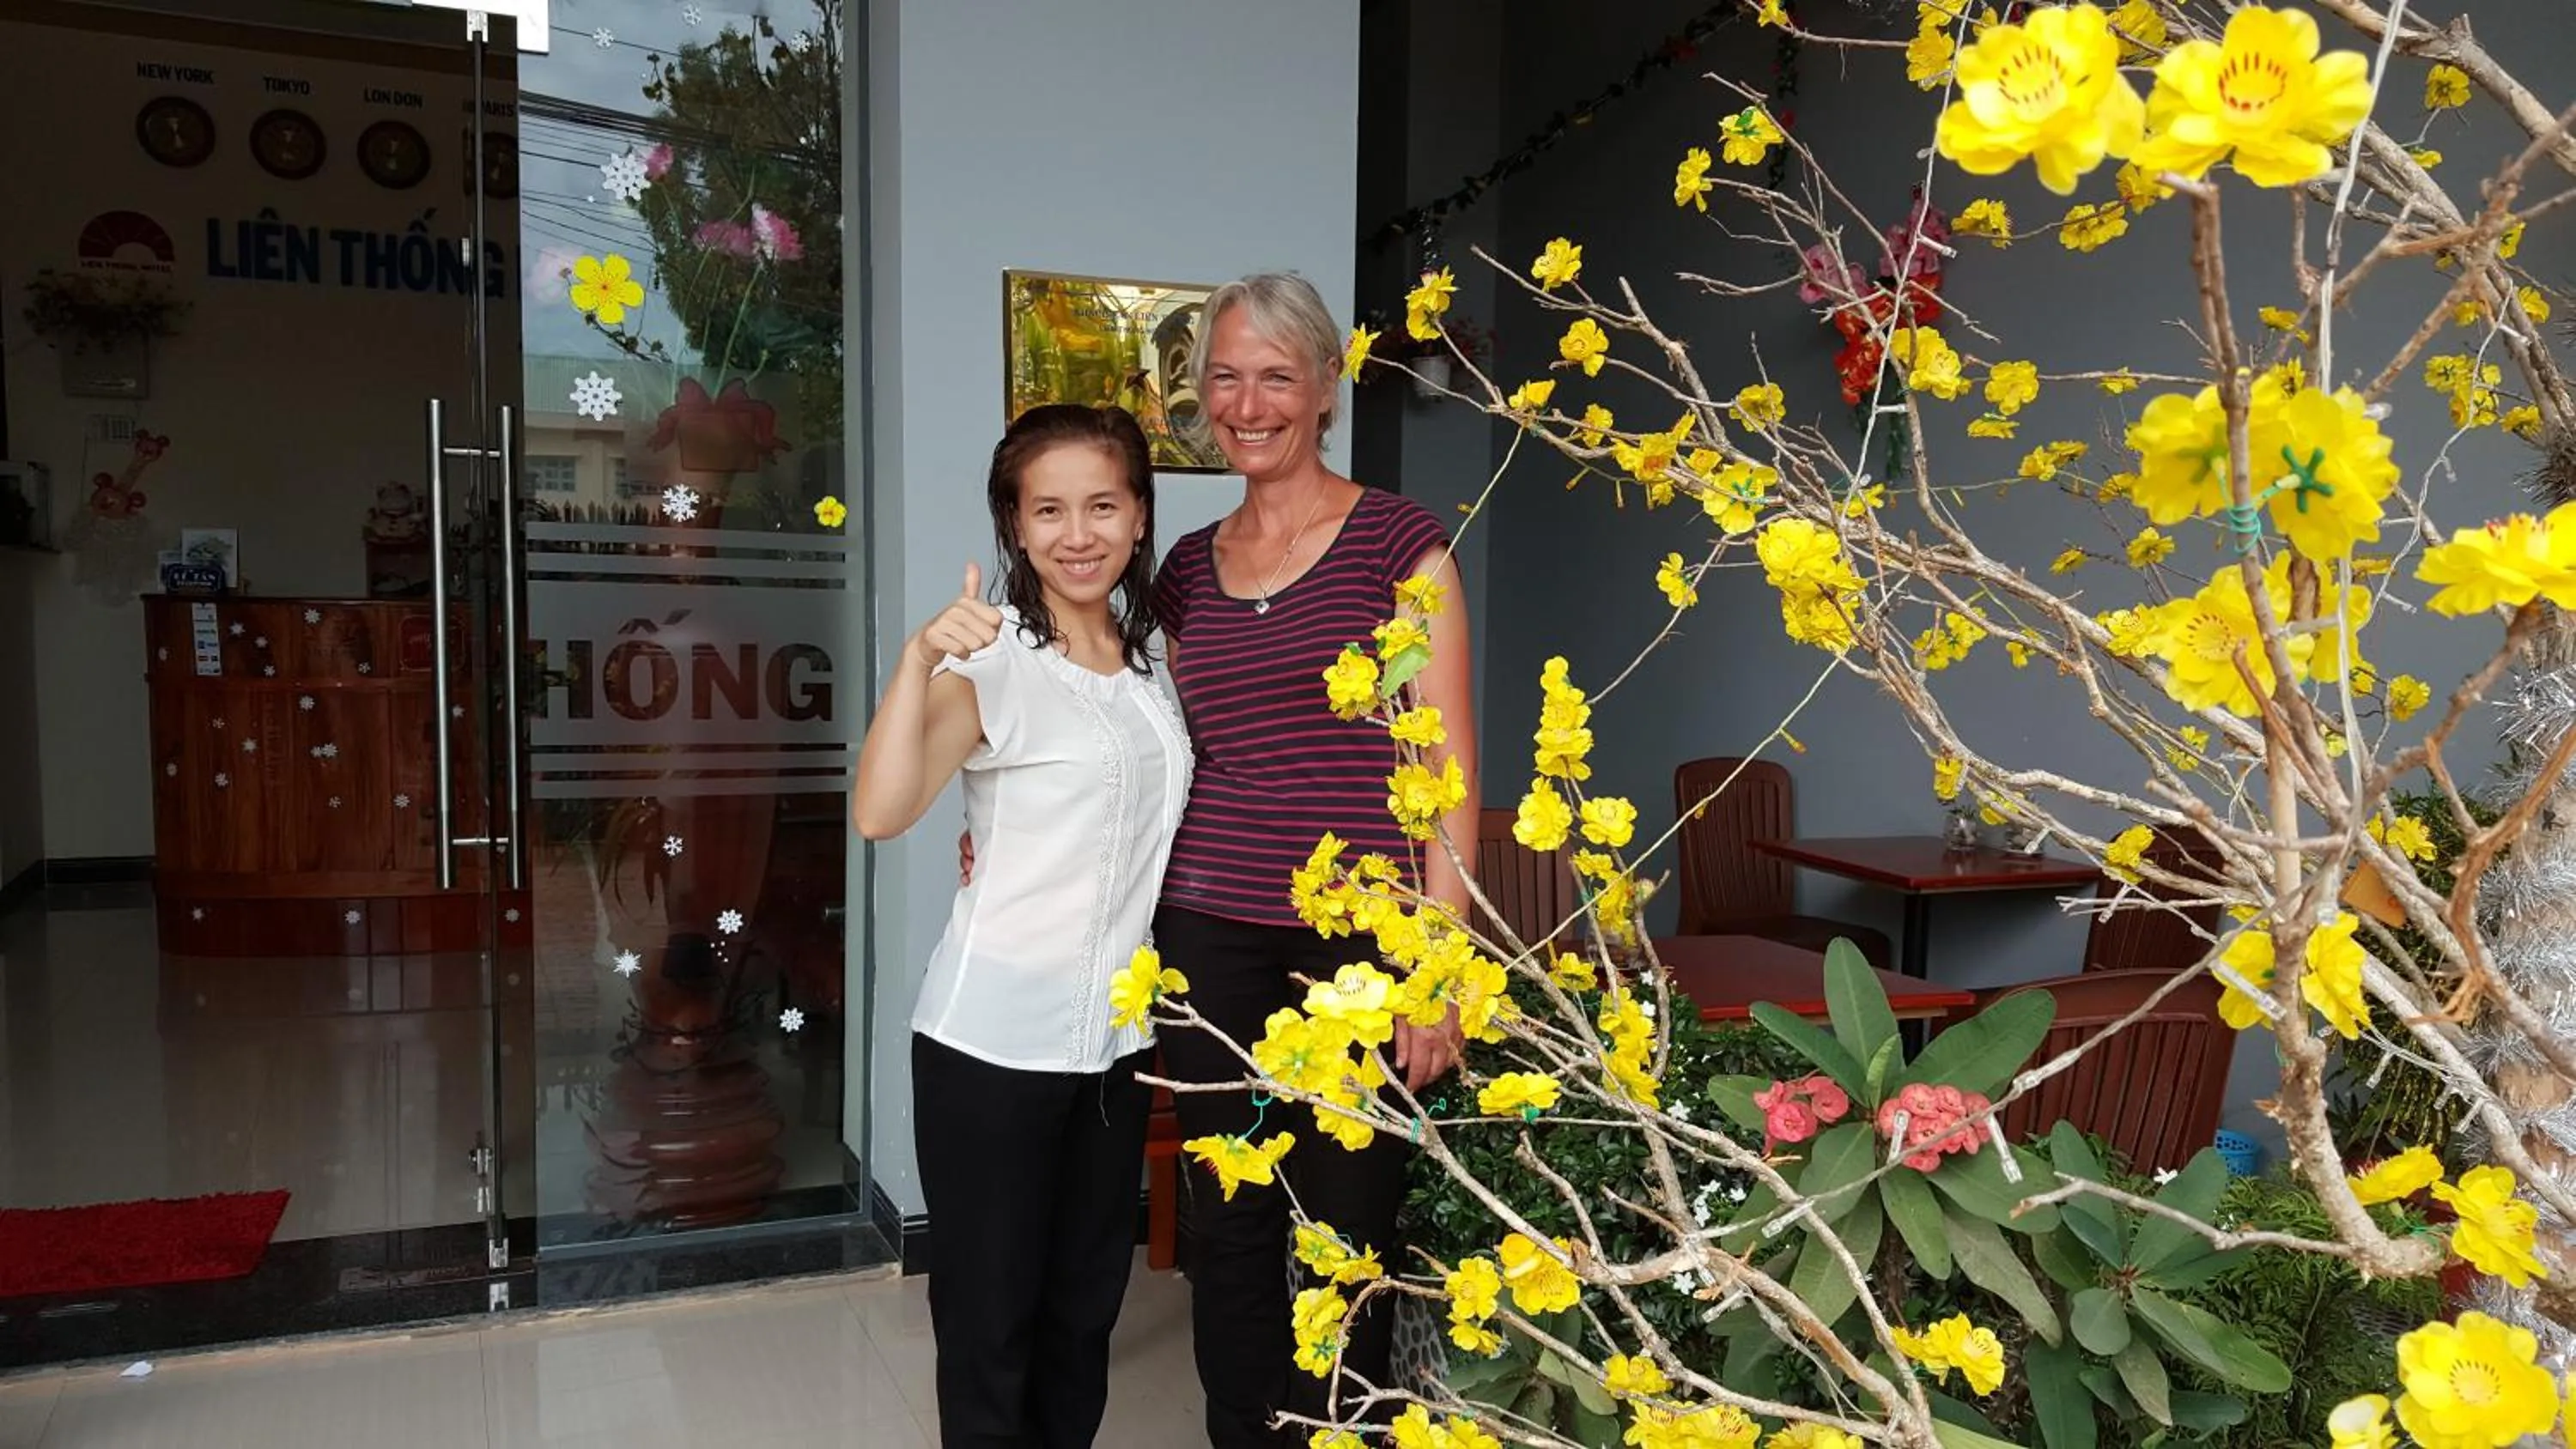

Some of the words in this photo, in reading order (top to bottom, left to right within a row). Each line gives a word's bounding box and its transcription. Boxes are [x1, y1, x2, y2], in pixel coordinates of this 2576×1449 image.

[137, 62, 171, 81] NEW
[174, 64, 215, 85] YORK
[263, 76, 310, 95] TOKYO
[206, 207, 319, 284] LIÊN
[330, 207, 503, 298] THỐNG
